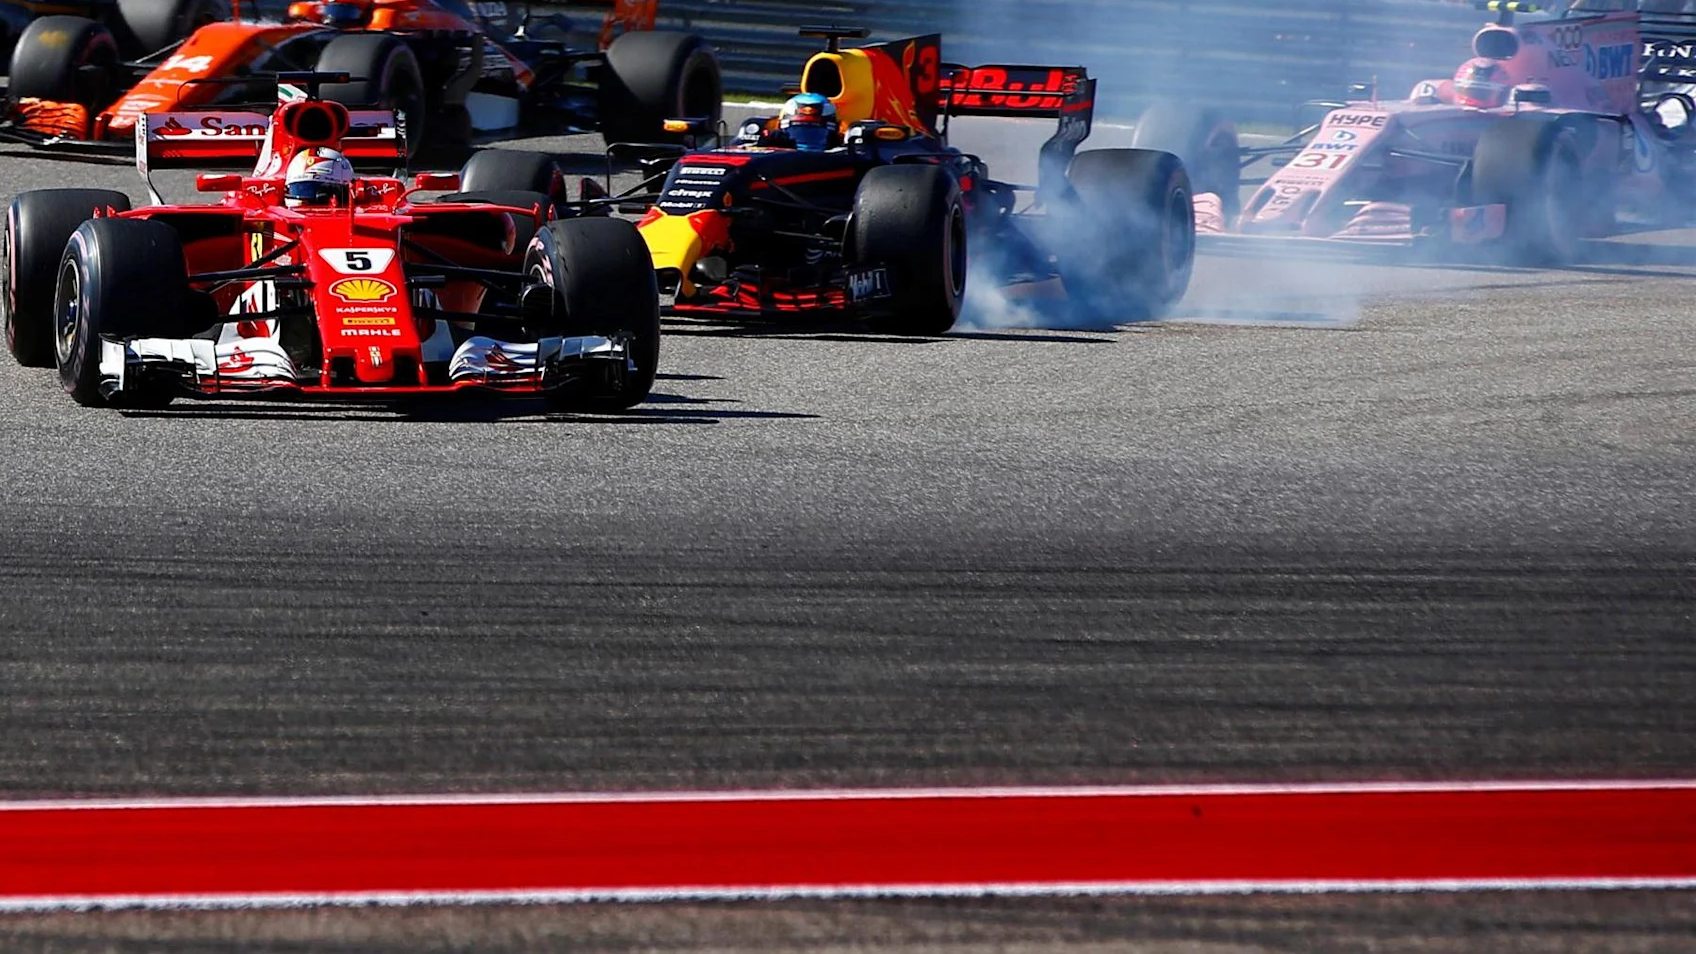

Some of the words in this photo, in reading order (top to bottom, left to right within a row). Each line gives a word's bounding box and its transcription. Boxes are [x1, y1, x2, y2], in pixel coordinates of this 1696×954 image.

[161, 55, 214, 73] 14
[917, 45, 938, 94] 3
[1598, 44, 1634, 80] BWT
[1329, 114, 1387, 127] HYPE
[1311, 143, 1359, 151] BWT
[1293, 153, 1348, 169] 31
[345, 251, 372, 271] 5
[340, 329, 402, 337] MAHLE
